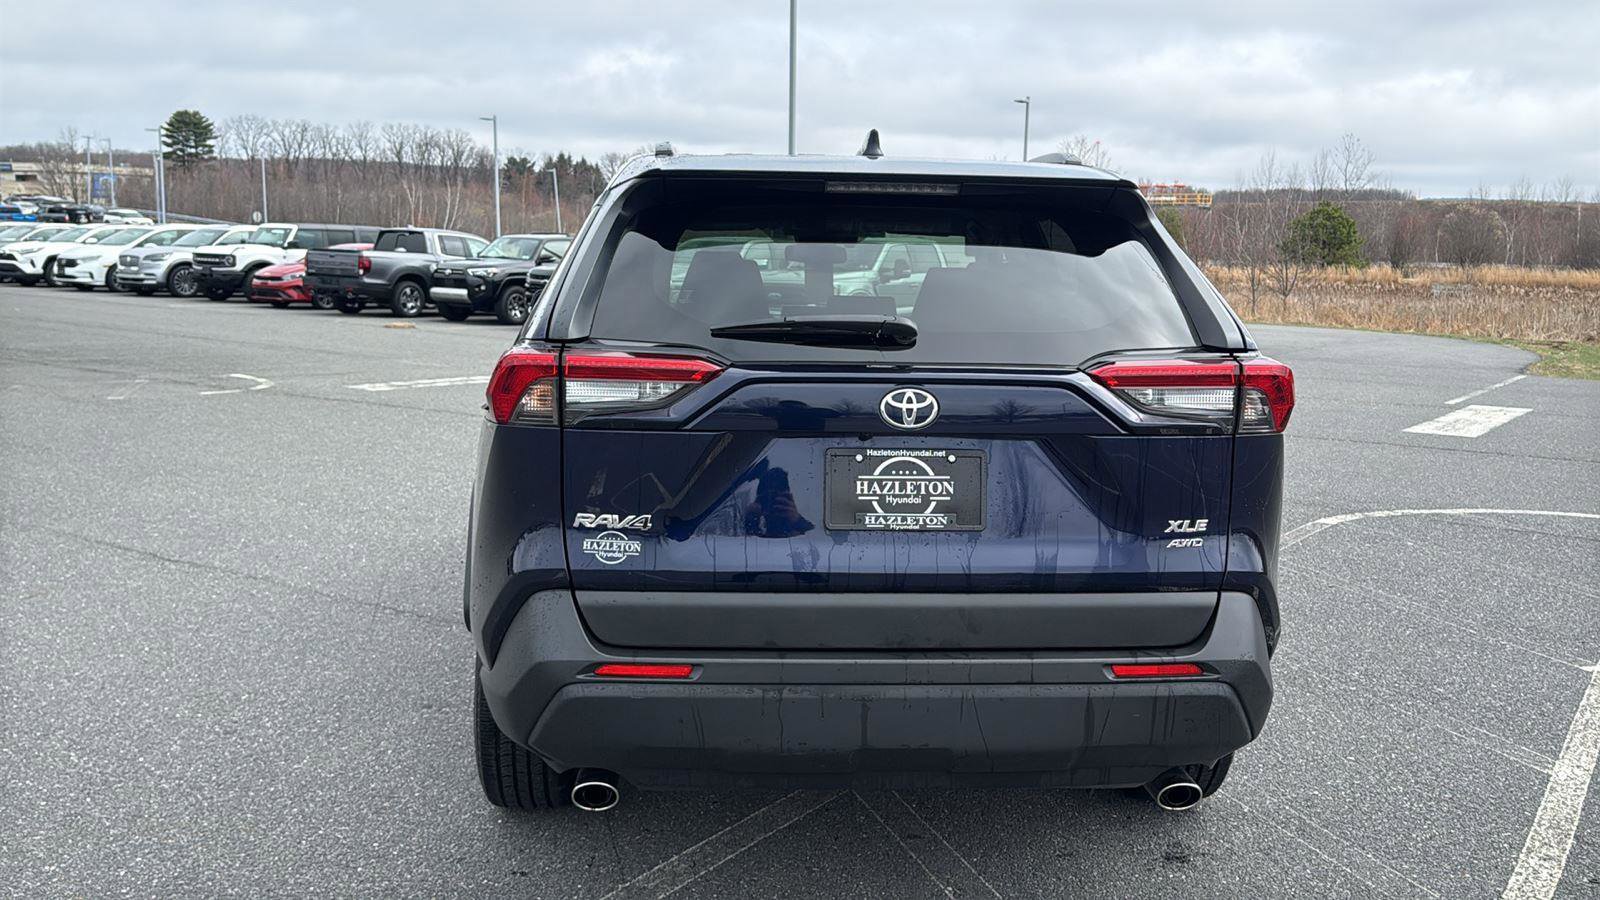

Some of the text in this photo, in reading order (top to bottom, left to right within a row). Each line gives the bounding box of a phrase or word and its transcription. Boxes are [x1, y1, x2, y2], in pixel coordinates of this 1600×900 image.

[867, 449, 946, 458] HazletonHyundai.net
[856, 480, 954, 495] HAZLETON
[885, 495, 922, 506] Hyundai
[573, 512, 652, 531] RAV4
[864, 516, 948, 525] HAZLETON
[1164, 519, 1209, 533] XLE
[582, 540, 641, 552] HAZLETON
[1166, 538, 1204, 548] AWD
[599, 550, 624, 558] Hyundai
